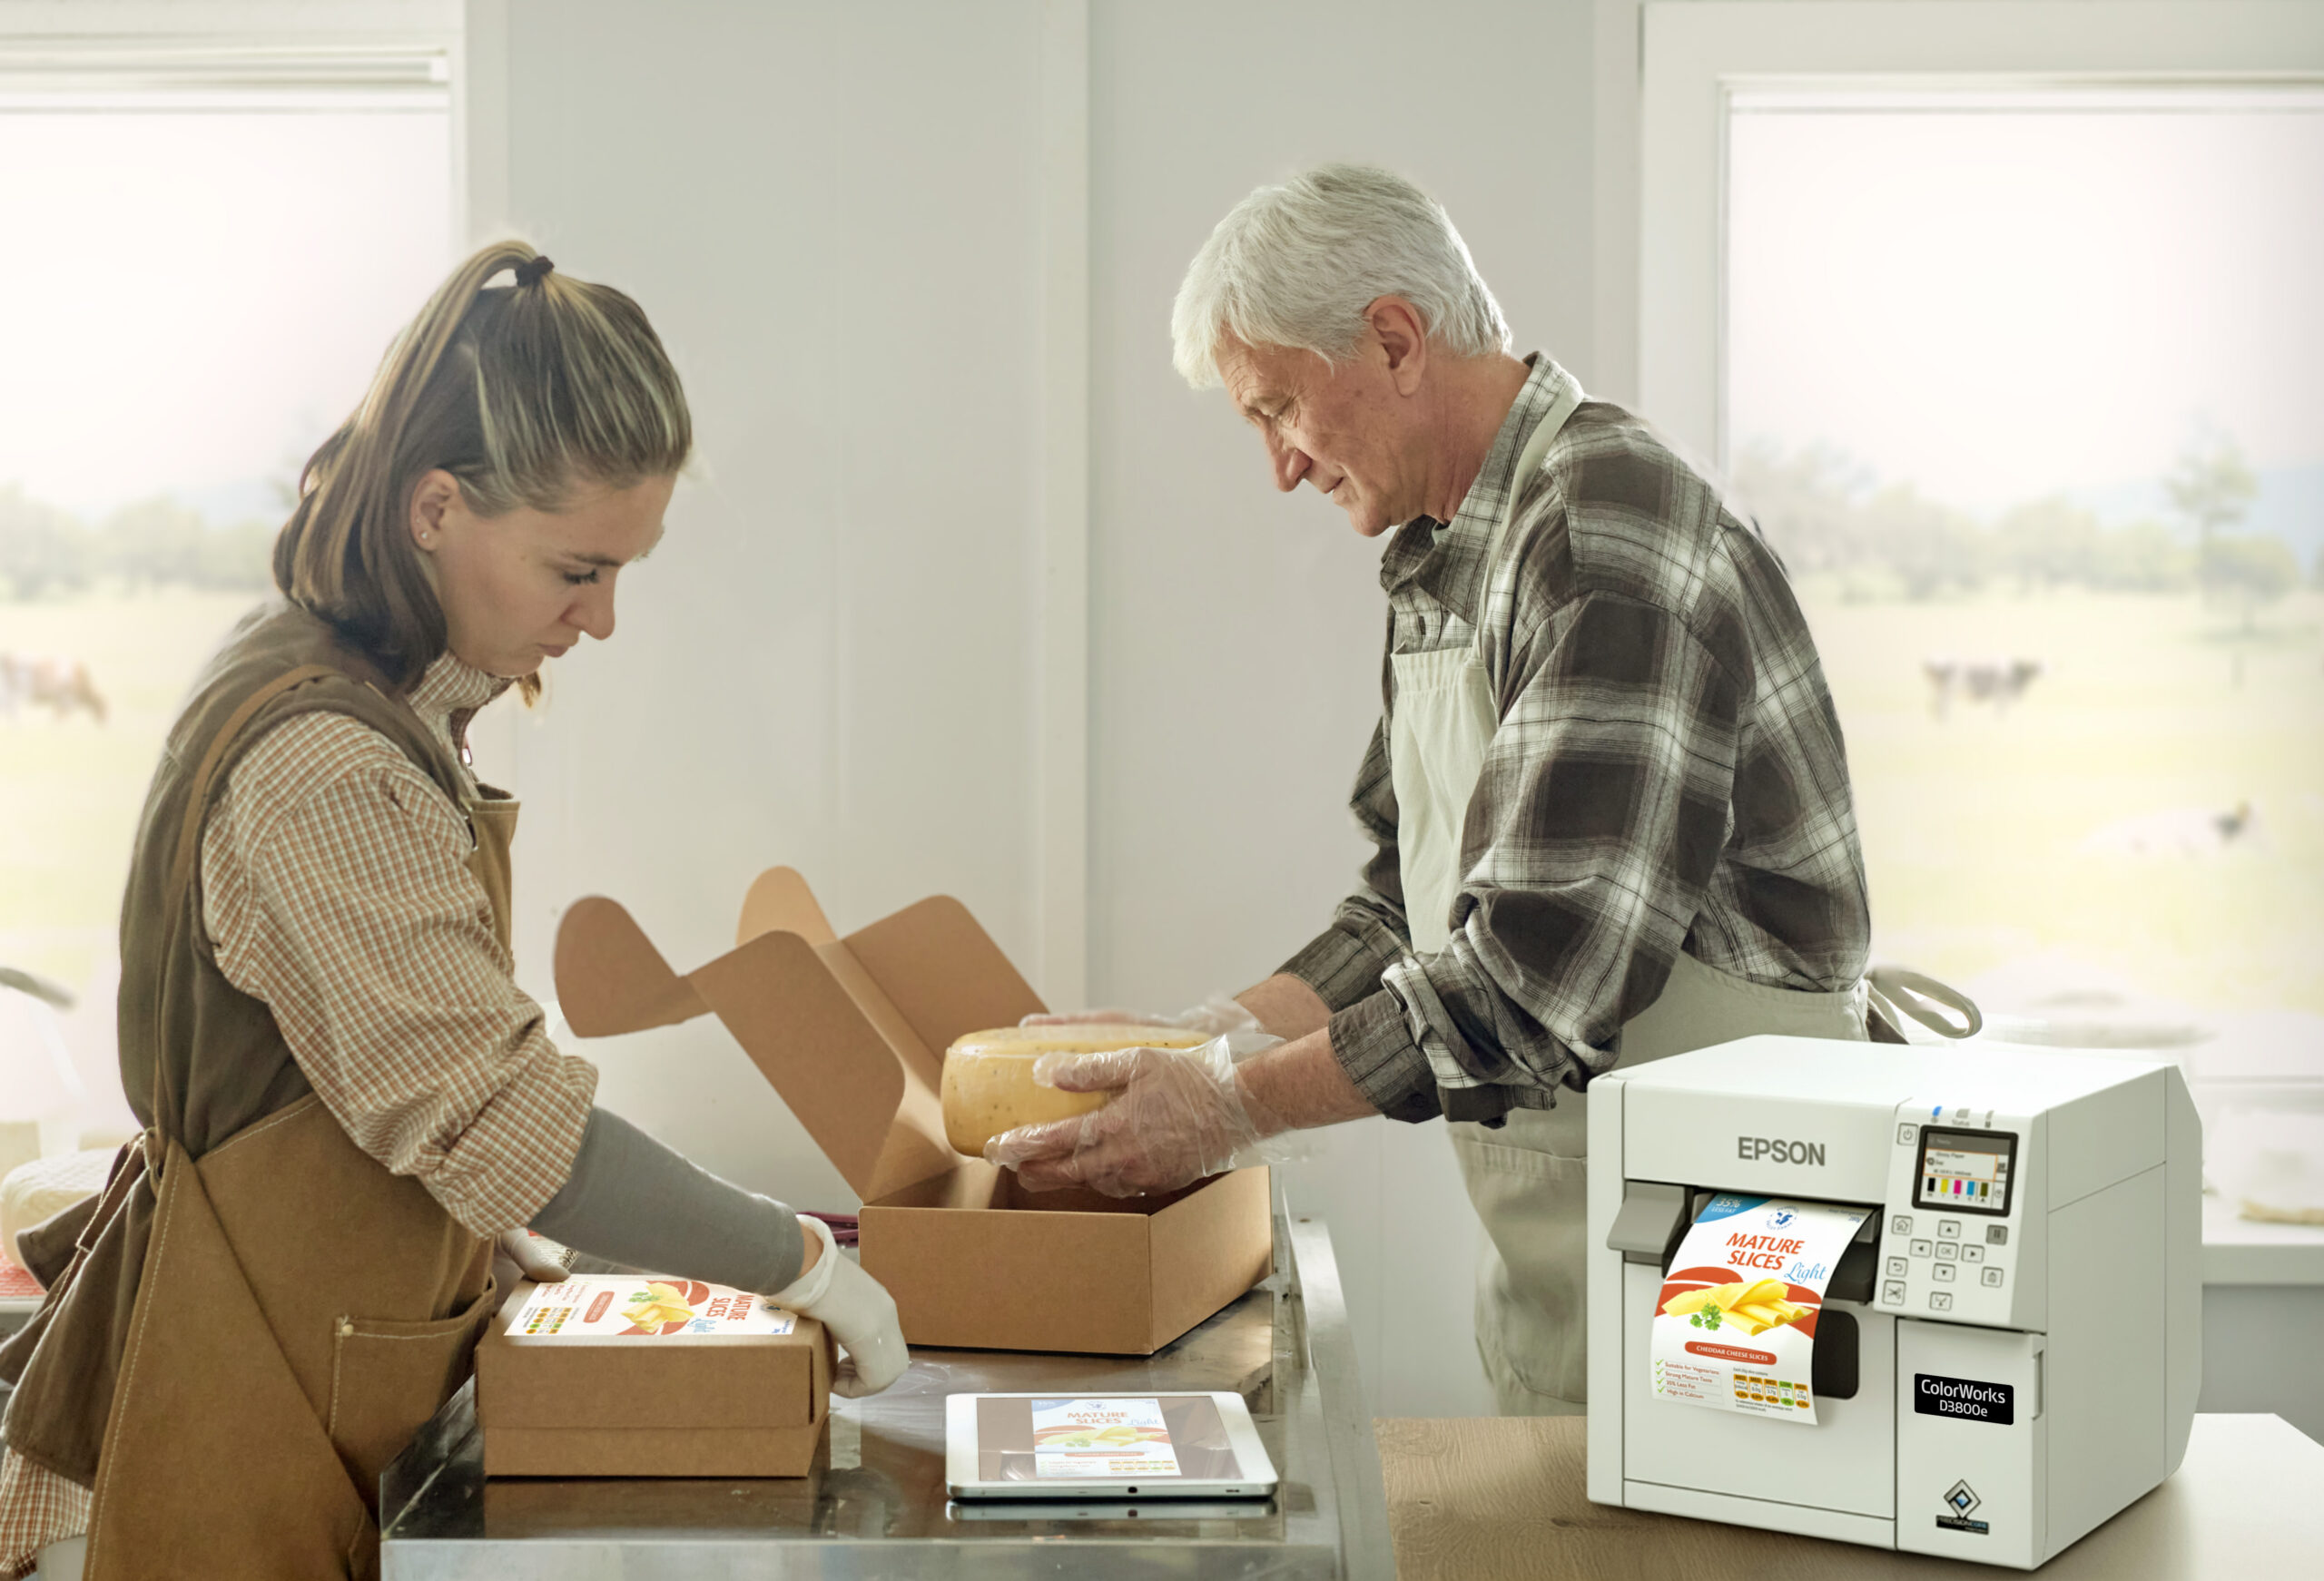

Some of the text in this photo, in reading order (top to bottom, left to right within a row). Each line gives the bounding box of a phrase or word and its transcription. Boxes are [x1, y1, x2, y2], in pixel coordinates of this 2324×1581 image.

[1738, 1136, 1825, 1166] EPSON
[1726, 1232, 1805, 1254] MATURE
[1727, 1250, 1786, 1270] SLICES
[1784, 1262, 1827, 1284] Light
[706, 1298, 732, 1317] SLICES
[726, 1294, 755, 1321] MATURE
[1696, 1345, 1768, 1361] CHEDDAR CHEESE SLICES
[1921, 1380, 2005, 1404] ColorWorks
[1939, 1399, 1988, 1417] D3800e
